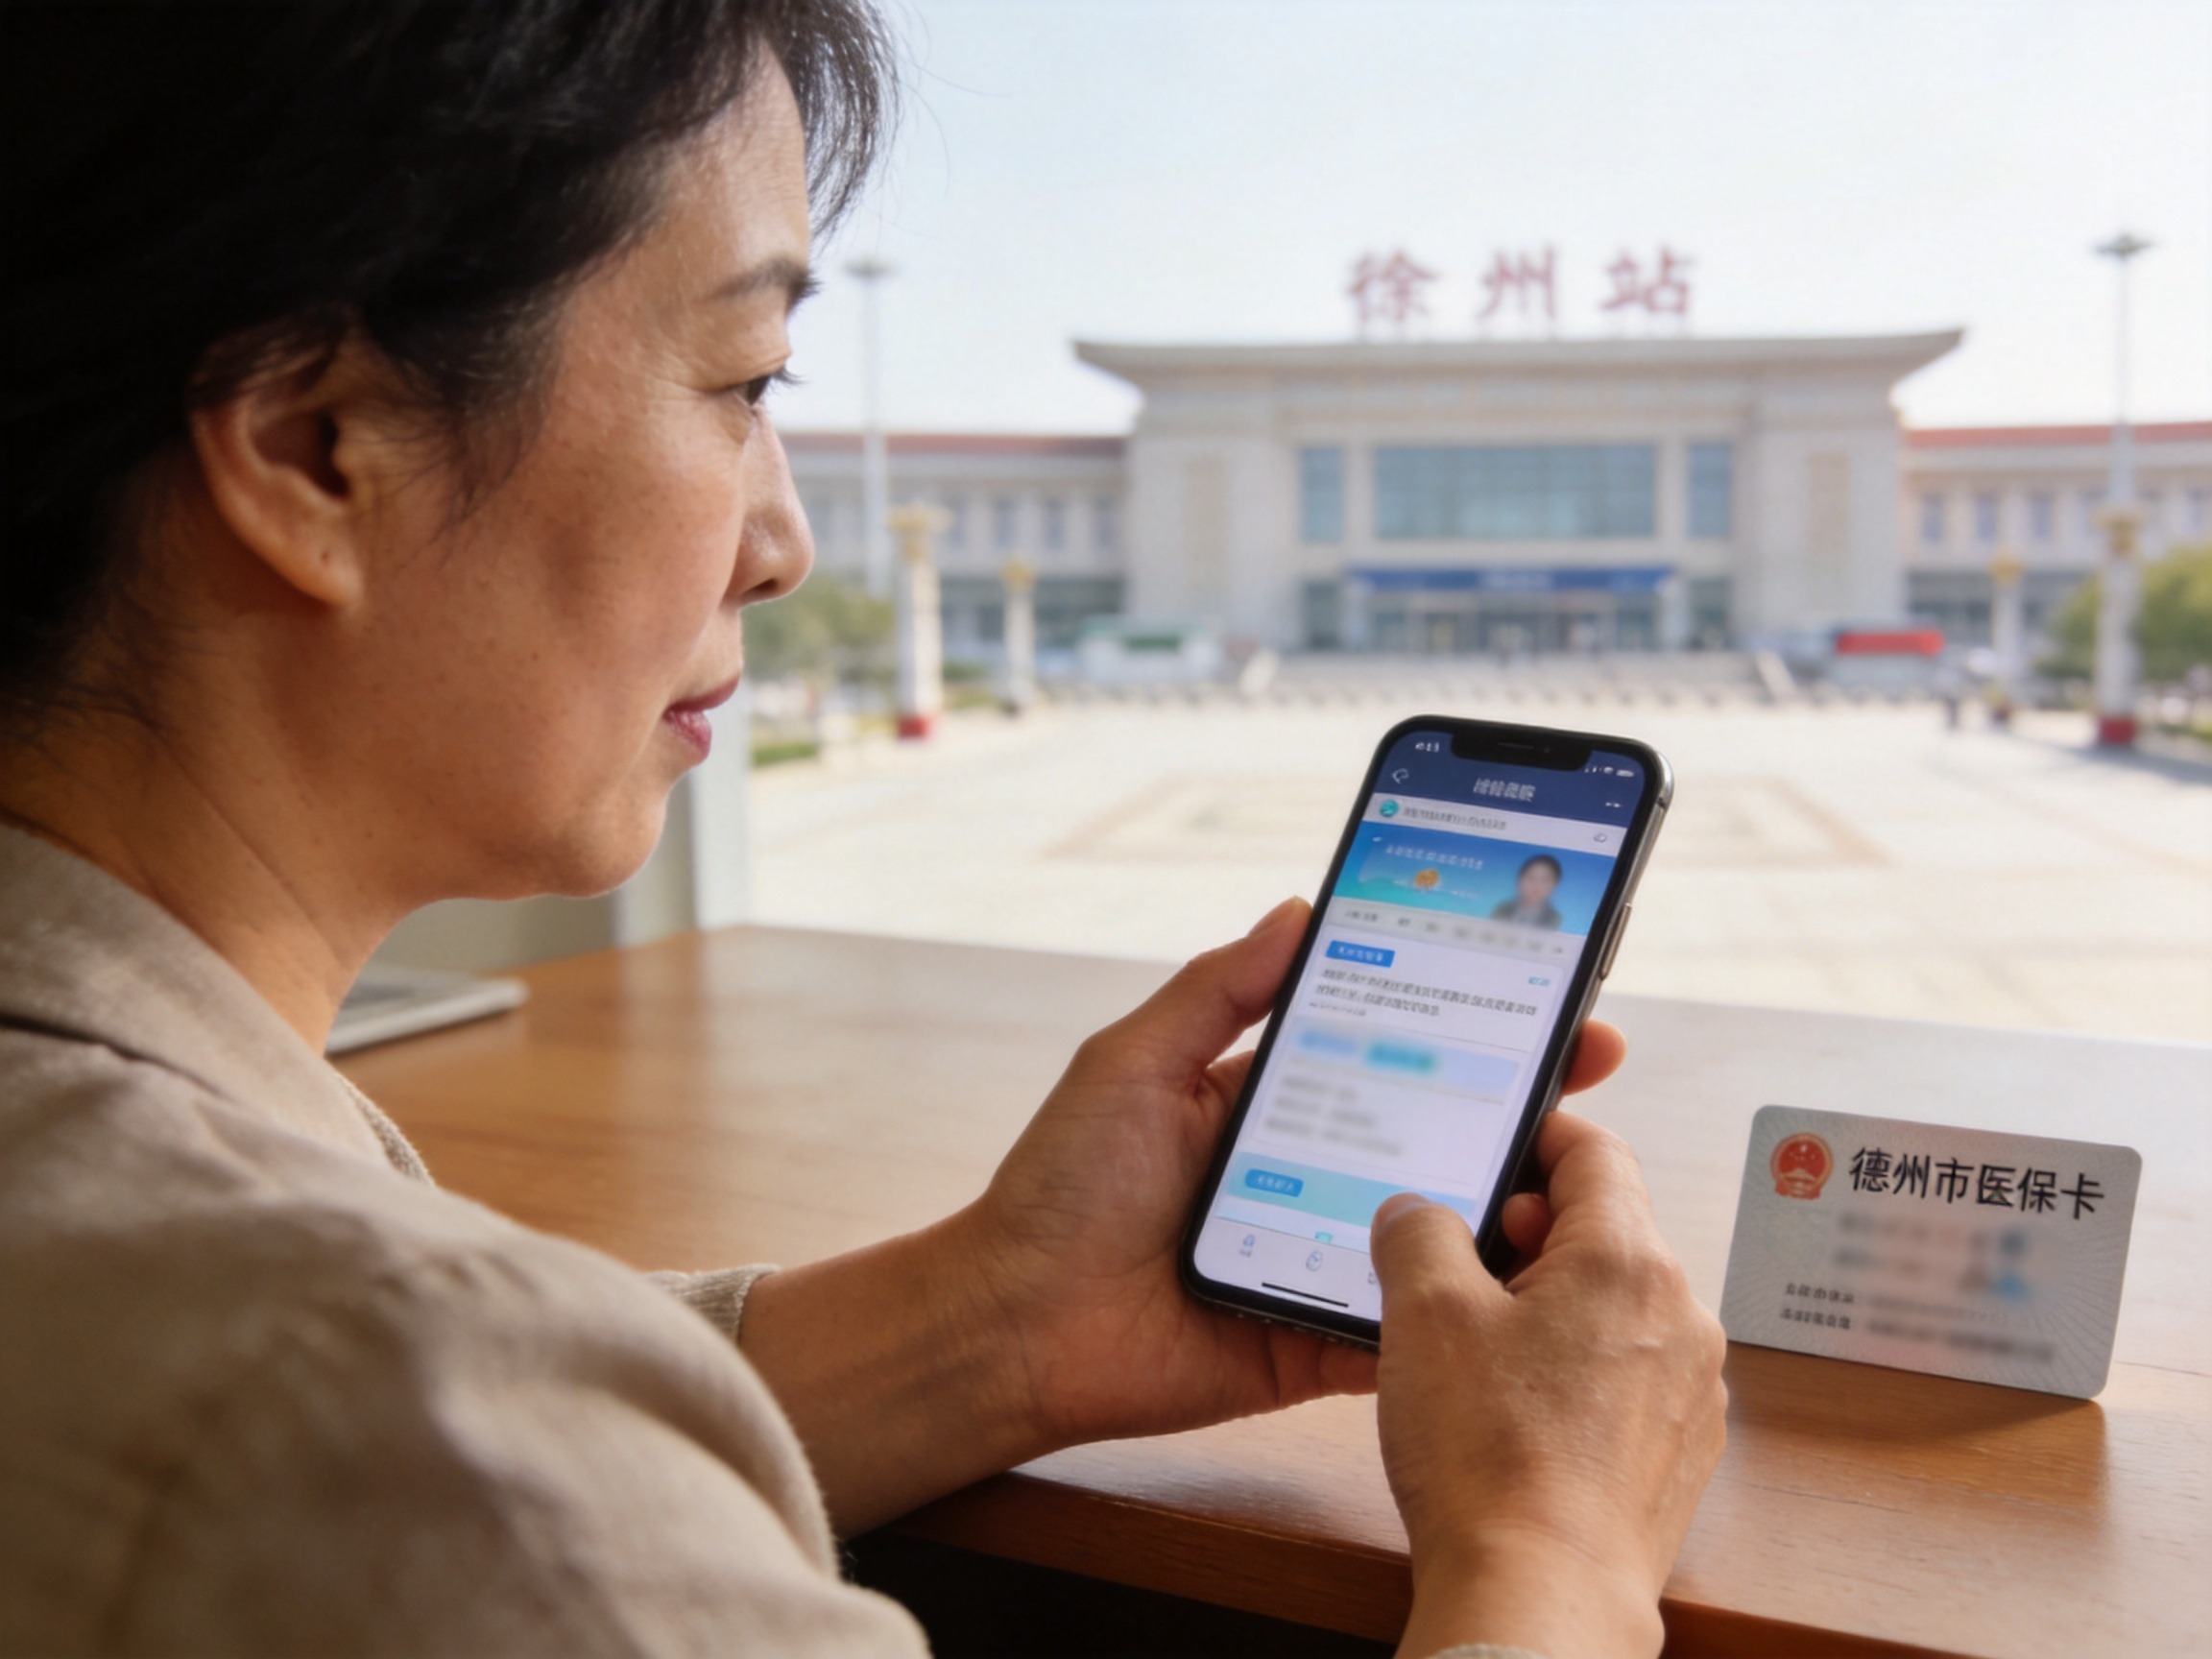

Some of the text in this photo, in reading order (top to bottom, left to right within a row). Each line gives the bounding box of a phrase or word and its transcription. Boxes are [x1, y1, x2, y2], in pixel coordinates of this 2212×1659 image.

[1347, 245, 1695, 323] 徐州站
[1849, 1146, 2105, 1220] 德州市医保卡
